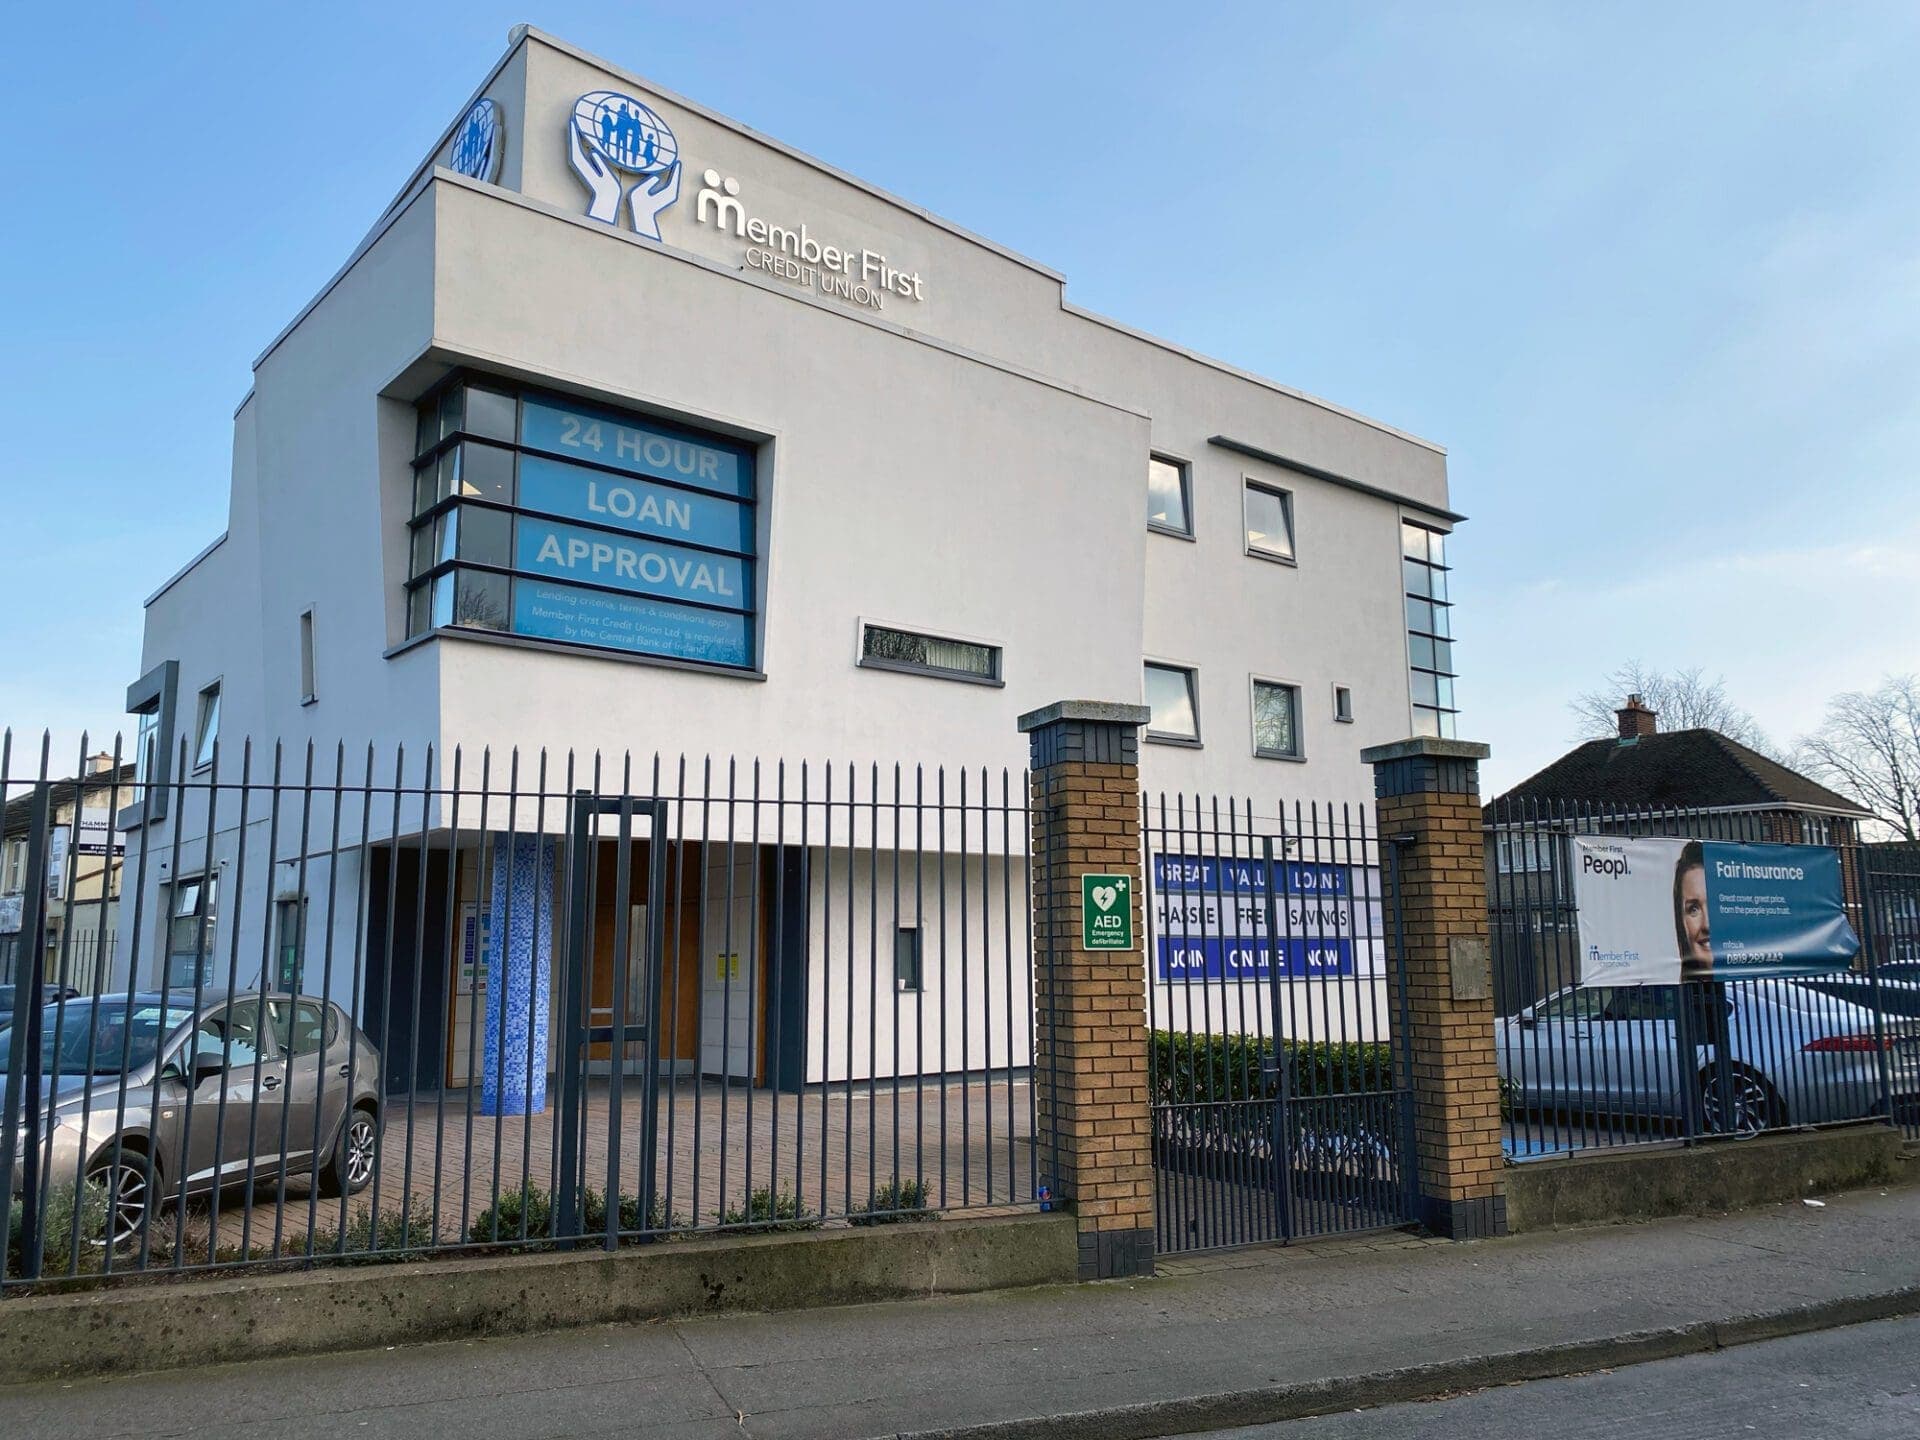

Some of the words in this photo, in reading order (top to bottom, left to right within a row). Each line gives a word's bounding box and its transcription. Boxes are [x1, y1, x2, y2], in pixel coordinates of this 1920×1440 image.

[746, 246, 816, 287] CREDIT
[820, 272, 884, 310] UNION
[861, 247, 924, 301] First
[560, 415, 604, 452] 24
[616, 428, 719, 480] HOUR
[588, 482, 690, 531] LOAN
[535, 533, 735, 596] APPROVAL
[536, 588, 577, 606] Lending
[531, 606, 575, 622] Member
[578, 612, 599, 626] First
[602, 616, 632, 630] Credit
[635, 621, 662, 634] Union
[564, 624, 577, 639] by
[580, 627, 597, 639] the
[599, 629, 635, 643] Central
[636, 634, 660, 648] Bank
[662, 641, 673, 650] of
[1160, 863, 1210, 883] GREAT
[1583, 854, 1632, 880] Peopl.
[1716, 860, 1741, 878] Fair
[1742, 862, 1804, 880] Insurance
[1094, 915, 1122, 928] AED
[1158, 905, 1216, 925] HASE
[1239, 907, 1268, 926] FRE
[1290, 908, 1348, 926] SVNGS
[1091, 929, 1124, 938] Emergency
[1170, 949, 1205, 968] JOIN
[1229, 949, 1286, 968] ONIE
